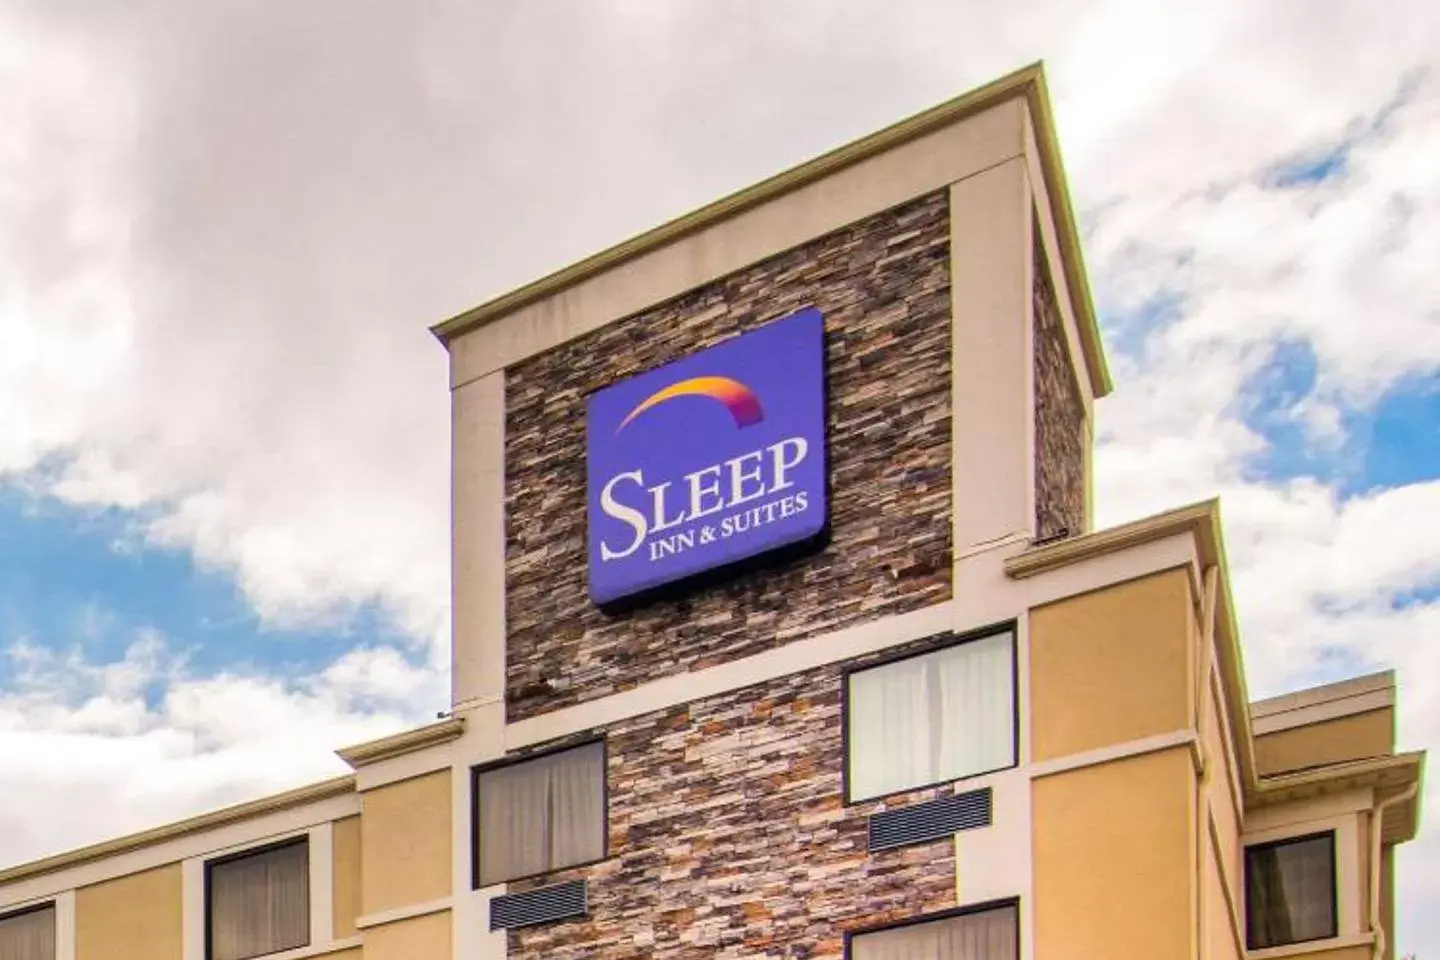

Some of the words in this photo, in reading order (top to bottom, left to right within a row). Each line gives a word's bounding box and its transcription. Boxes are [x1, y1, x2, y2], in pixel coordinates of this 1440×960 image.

[600, 437, 808, 561] SLEEP
[649, 530, 694, 561] INN
[700, 525, 717, 544] &
[721, 491, 808, 537] SUITES
